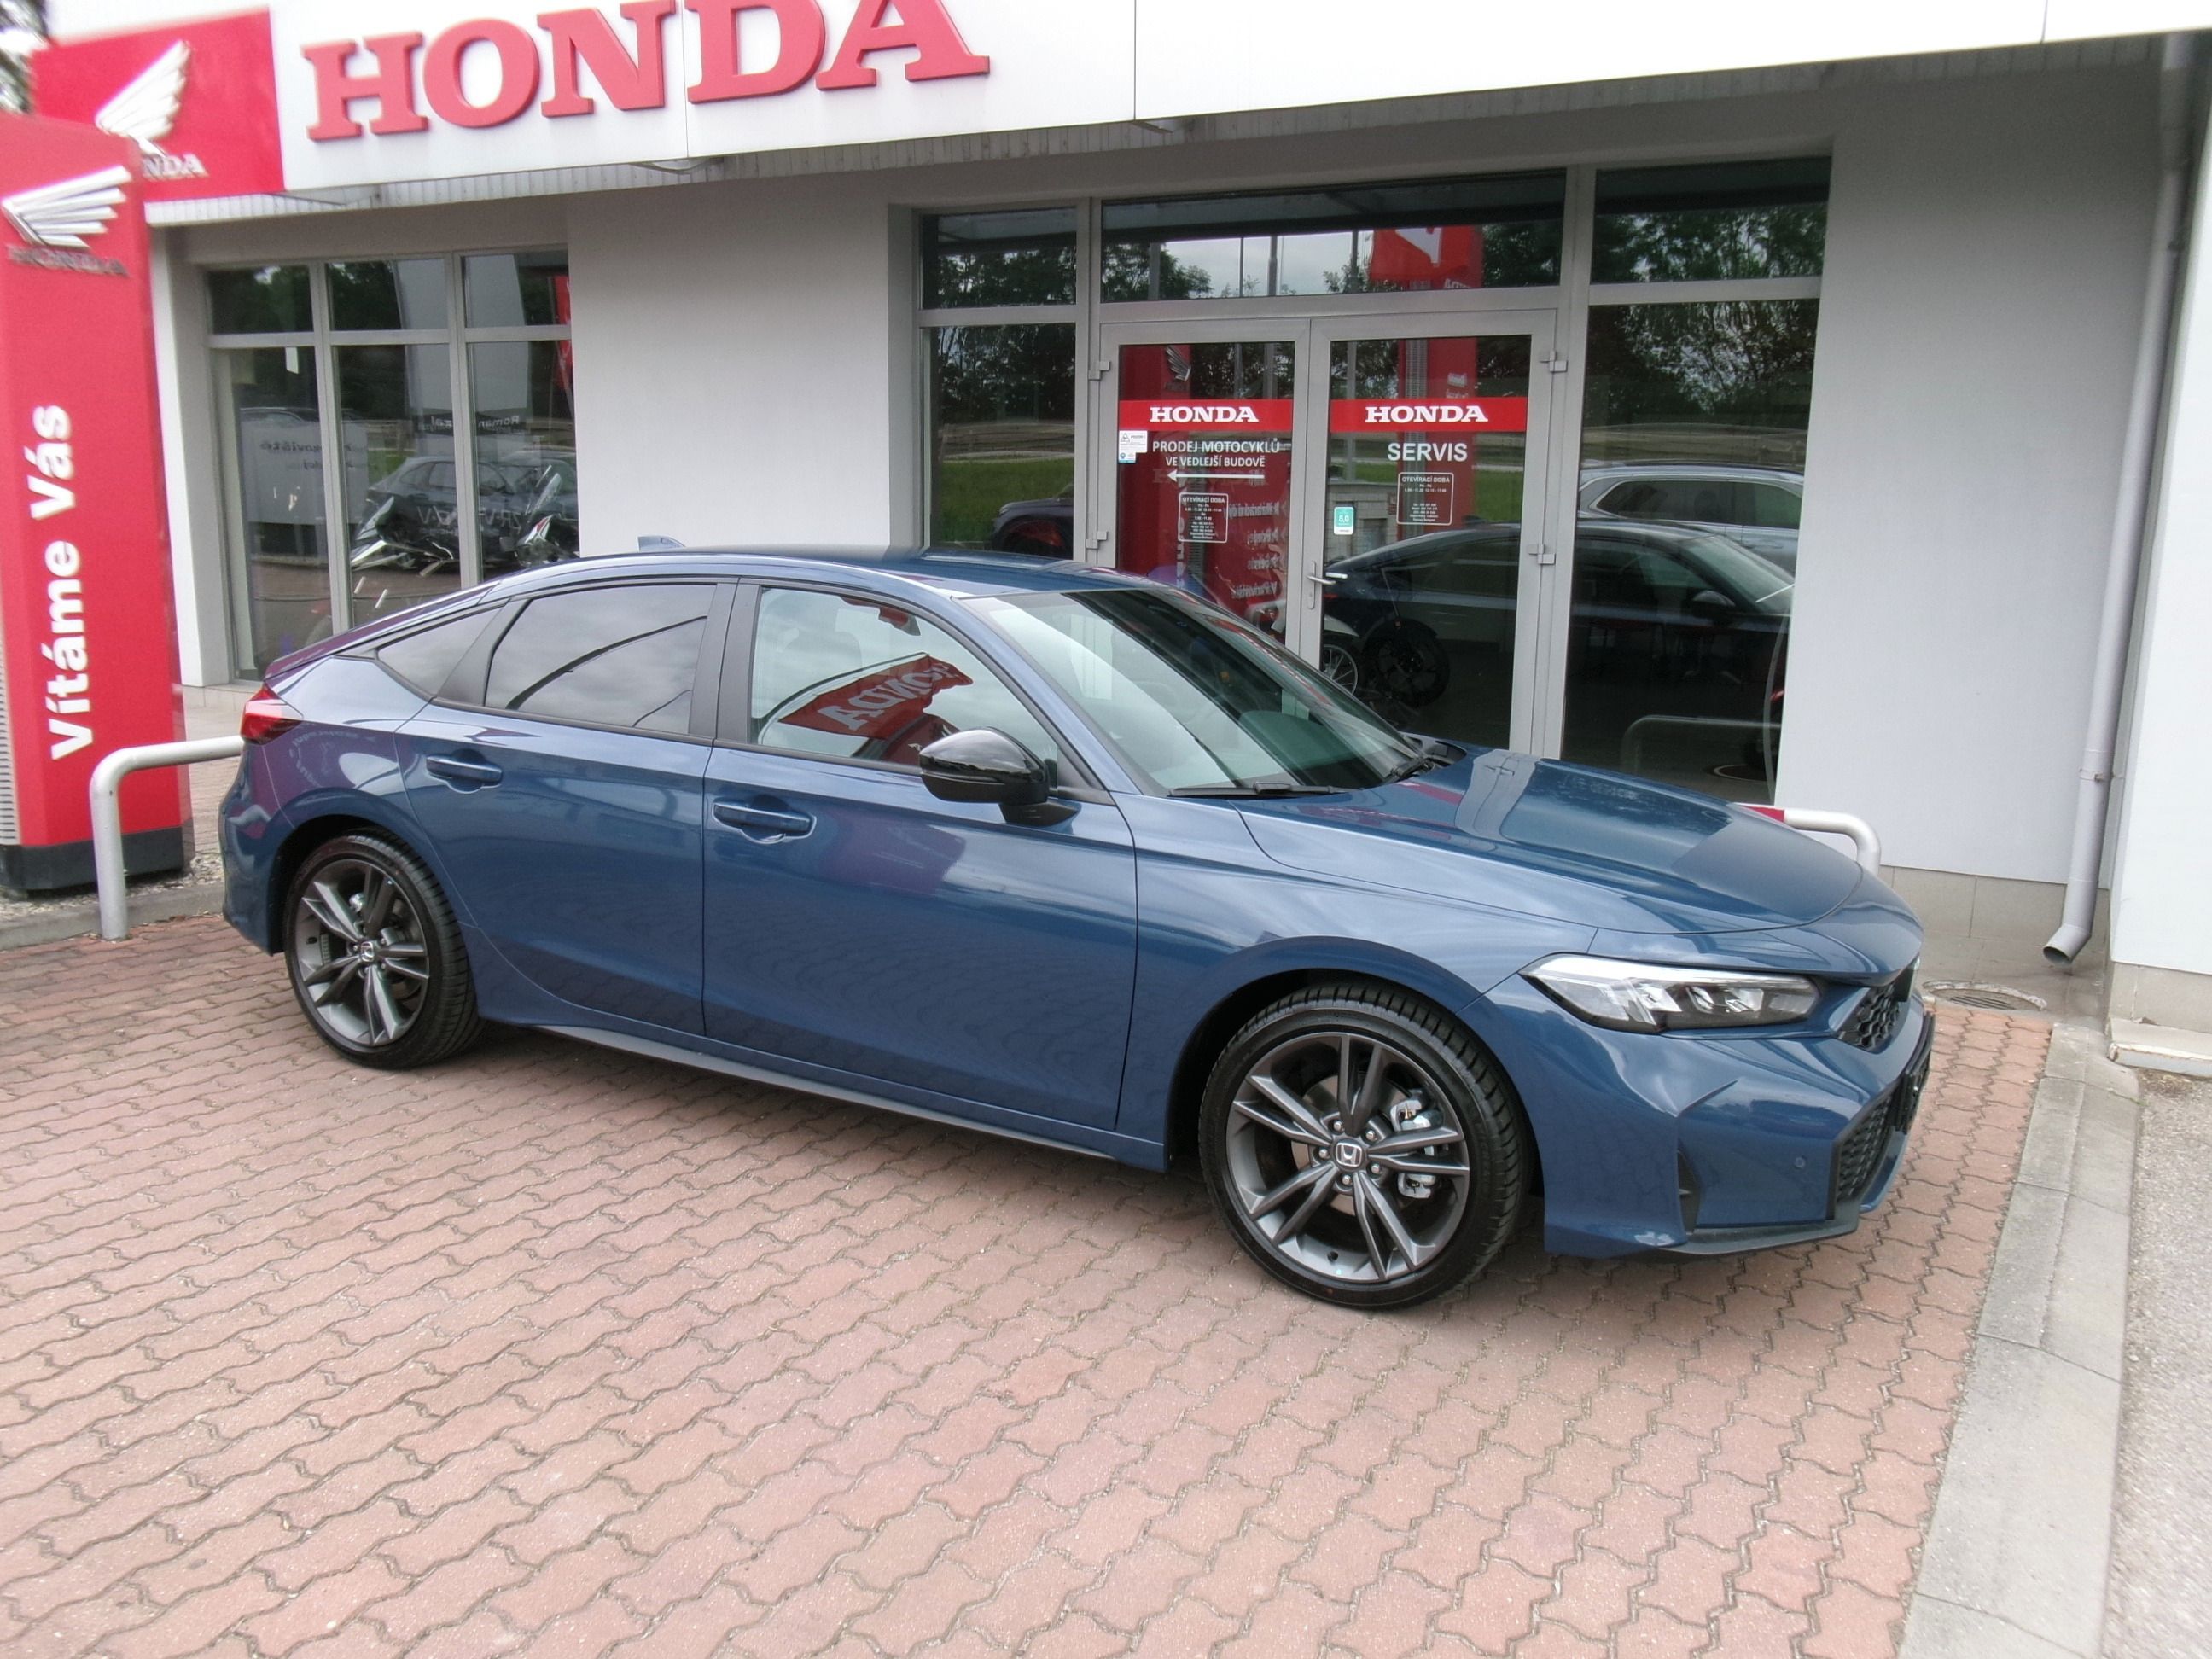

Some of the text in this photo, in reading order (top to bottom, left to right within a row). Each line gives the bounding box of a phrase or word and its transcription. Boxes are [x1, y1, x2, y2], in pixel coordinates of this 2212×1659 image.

[300, 0, 991, 142] HONDA
[142, 152, 209, 181] NDA
[1150, 406, 1260, 422] HONDA
[1365, 405, 1488, 422] HONDA
[1152, 440, 1198, 453] PRODEJ
[1202, 438, 1280, 453] MOTOCYKLŮ
[1387, 442, 1468, 461] SERVIS
[1166, 455, 1266, 467] VE VEDLEJŠÍ BUDOVĚ
[24, 404, 94, 760] Vítáme Vás
